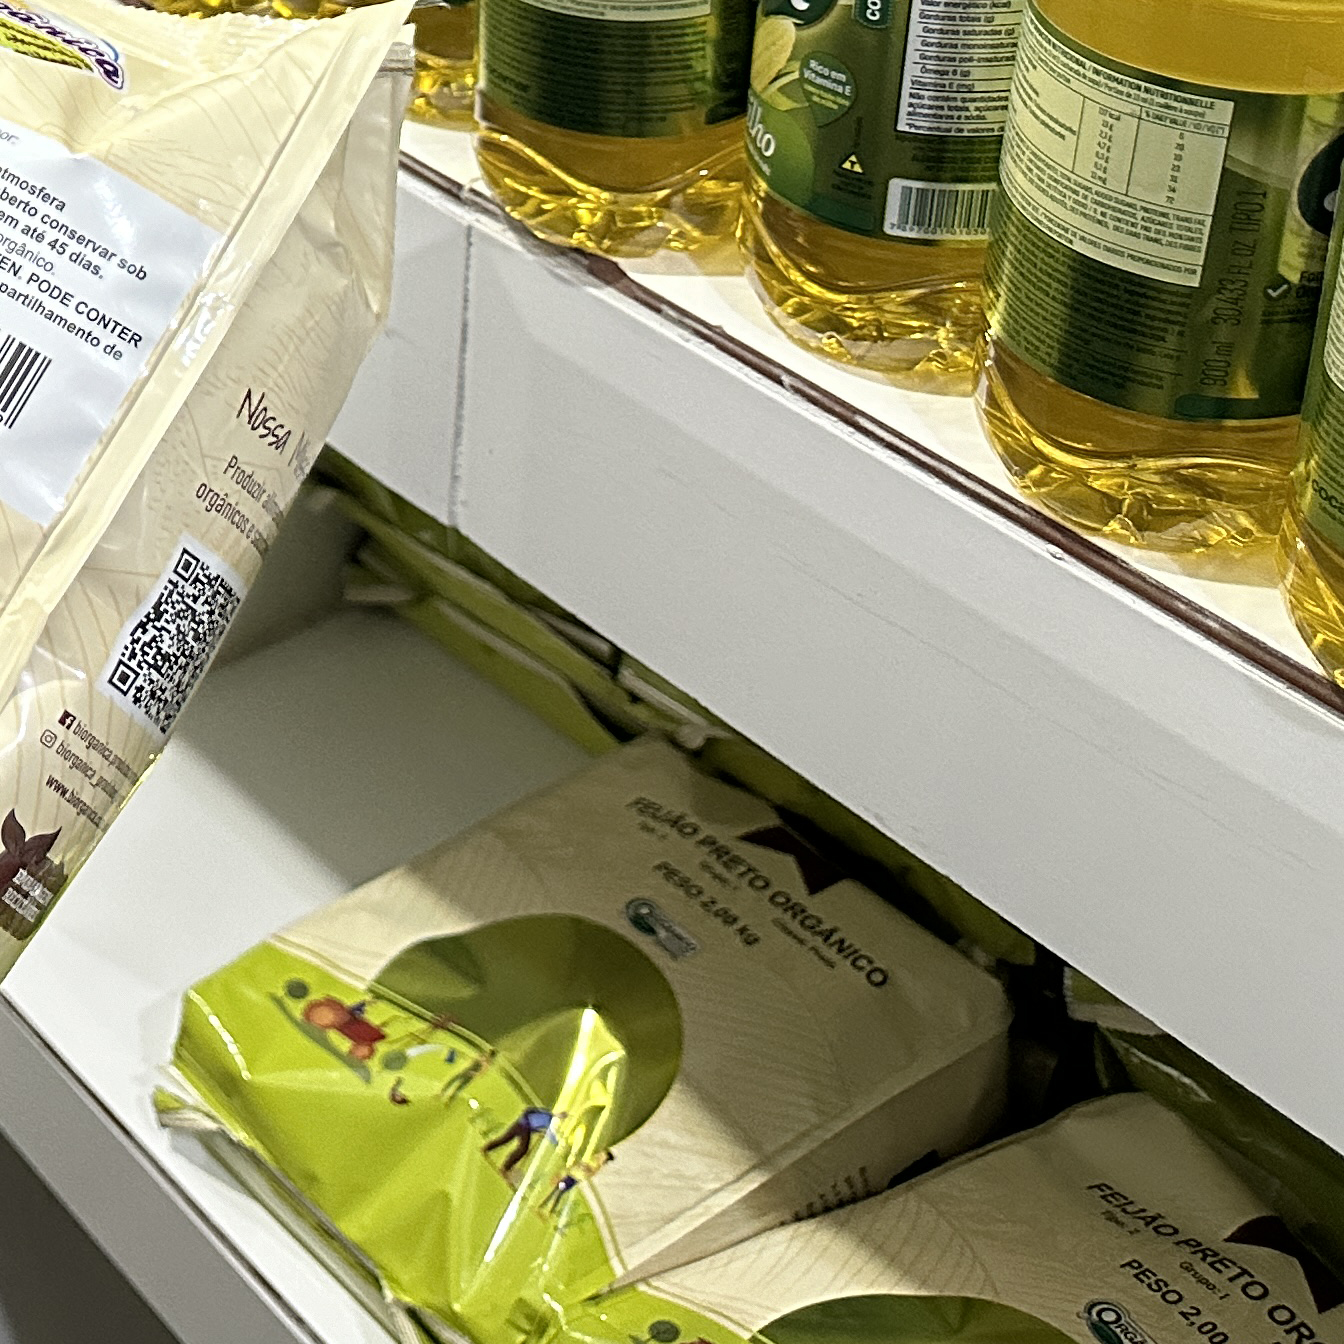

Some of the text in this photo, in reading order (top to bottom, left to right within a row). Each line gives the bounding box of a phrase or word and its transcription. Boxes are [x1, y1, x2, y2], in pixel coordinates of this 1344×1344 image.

[21, 225, 46, 243] até
[48, 239, 68, 255] 45
[69, 252, 103, 279] dias.
[41, 214, 117, 261] conservar
[118, 259, 146, 280] sob
[27, 273, 74, 307] PODE
[75, 302, 142, 348] CONTER
[103, 344, 122, 360] de
[223, 455, 266, 502] Produzir
[196, 483, 249, 533] orgânicos
[768, 890, 889, 988] ORGÂNICO
[1086, 1182, 1179, 1236] FEIJÃO
[1173, 1238, 1269, 1301] PRETO
[1267, 1304, 1344, 1344] OR
[1120, 1258, 1184, 1306] PESO
